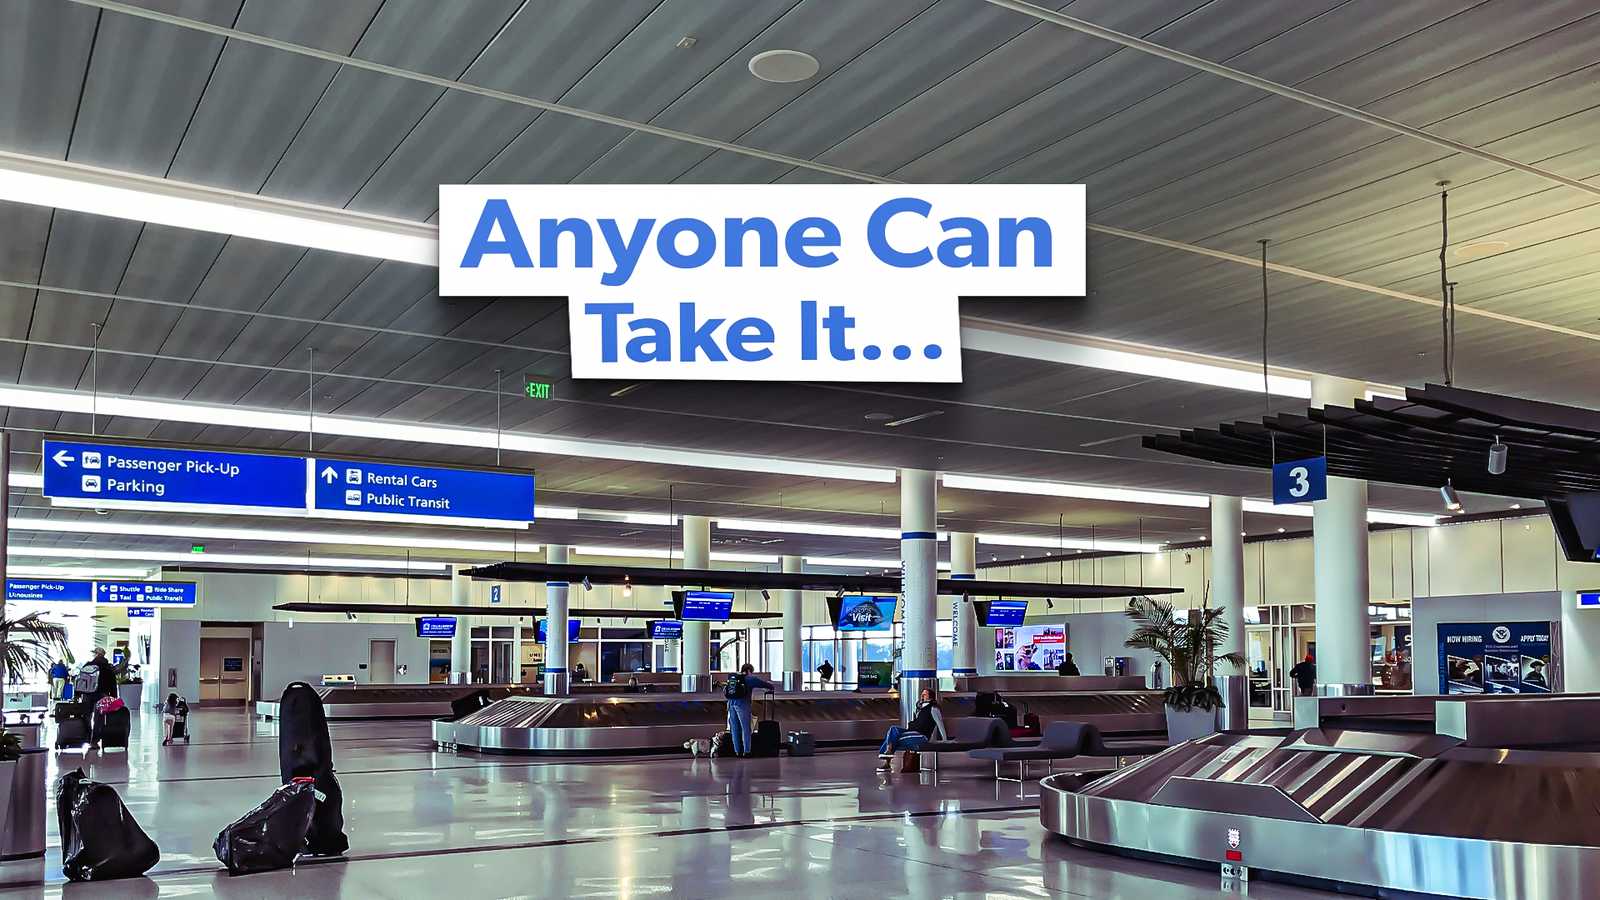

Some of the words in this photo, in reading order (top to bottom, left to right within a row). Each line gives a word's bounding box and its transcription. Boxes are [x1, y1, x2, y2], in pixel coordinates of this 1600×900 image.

[530, 382, 550, 399] EXIT
[107, 456, 182, 474] Passenger
[187, 460, 240, 478] Pick-Up
[107, 478, 165, 496] Parking
[367, 473, 407, 487] Rental
[411, 475, 438, 489] Cars
[1289, 467, 1310, 497] 3
[367, 493, 405, 508] Public
[408, 495, 450, 509] Transit
[9, 582, 40, 591] Passenger
[41, 583, 65, 592] Pick-Up
[493, 588, 499, 601] 2
[852, 613, 872, 622] Visit
[1447, 635, 1461, 643] NOW
[1462, 635, 1483, 643] HIRING
[1520, 635, 1535, 643] APPLY
[1536, 634, 1549, 642] TODAY
